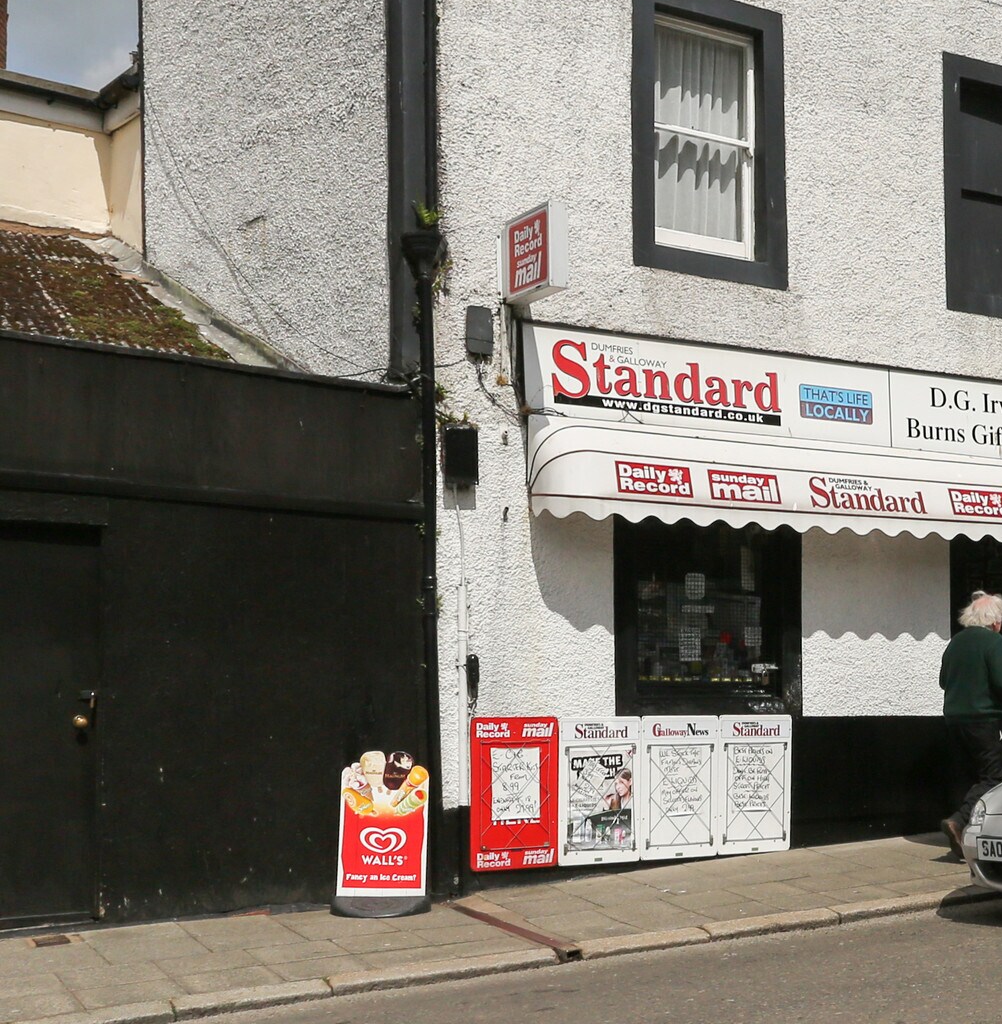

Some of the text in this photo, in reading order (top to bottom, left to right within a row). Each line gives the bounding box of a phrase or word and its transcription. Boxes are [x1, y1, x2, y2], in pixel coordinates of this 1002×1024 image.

[514, 226, 533, 244] Daily
[514, 233, 542, 257] Record
[514, 251, 542, 288] mail
[591, 342, 633, 355] DUMFRIES
[616, 356, 667, 369] GALLOWAY
[551, 339, 782, 413] Standard
[804, 387, 869, 406] THAT'S LIFE
[930, 387, 976, 411] D.G.
[602, 397, 764, 424] www.dgstandard.co.uk
[805, 403, 870, 422] LOCALLY
[907, 418, 965, 443] Burns
[618, 464, 667, 483] Daily
[711, 473, 765, 486] sunday
[828, 477, 862, 485] DUMFRIES
[620, 478, 691, 495] Record
[712, 480, 779, 503] mail
[809, 476, 928, 514] Standard
[952, 491, 990, 506] Daily
[476, 723, 500, 732] Daily
[476, 730, 511, 738] Record
[522, 722, 554, 738] mail
[574, 723, 628, 739] Standard
[687, 723, 709, 736] News
[733, 722, 780, 736] Standard
[603, 756, 621, 766] THE
[476, 852, 500, 862] Daily
[522, 848, 555, 865] mail
[524, 848, 548, 856] sunday
[362, 855, 404, 866] WALL'S
[477, 858, 511, 869] Record
[346, 873, 368, 883] Fancy
[380, 873, 390, 881] Ice
[392, 873, 417, 881] Cream?
